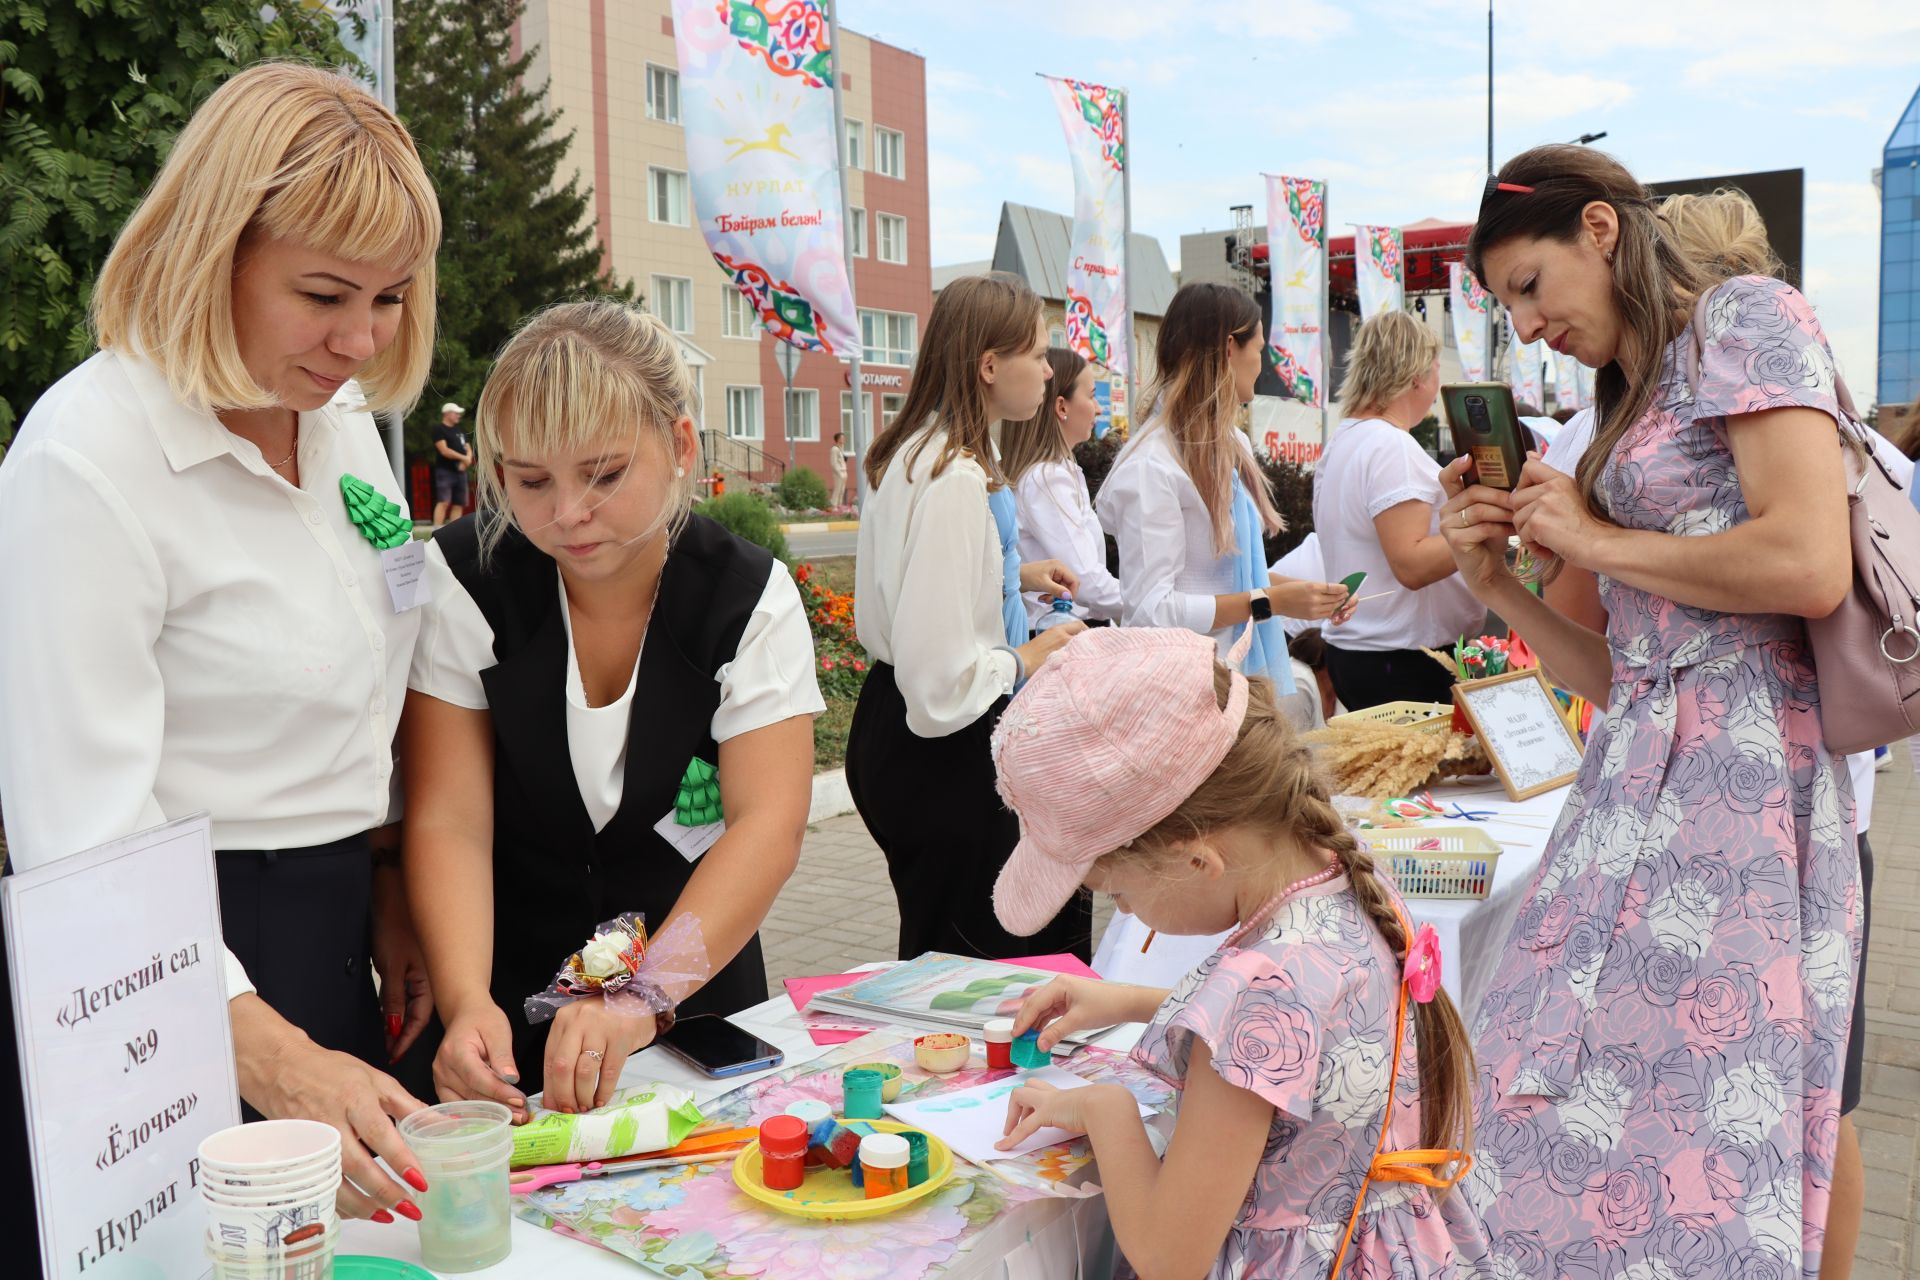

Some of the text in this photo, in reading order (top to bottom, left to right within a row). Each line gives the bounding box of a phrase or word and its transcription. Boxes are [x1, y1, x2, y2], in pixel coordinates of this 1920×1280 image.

[56, 943, 200, 1032] «Детский сад
[124, 1029, 158, 1073] №9
[96, 1092, 198, 1171] «Ёлочка»
[77, 1180, 178, 1274] г.Нурлат
